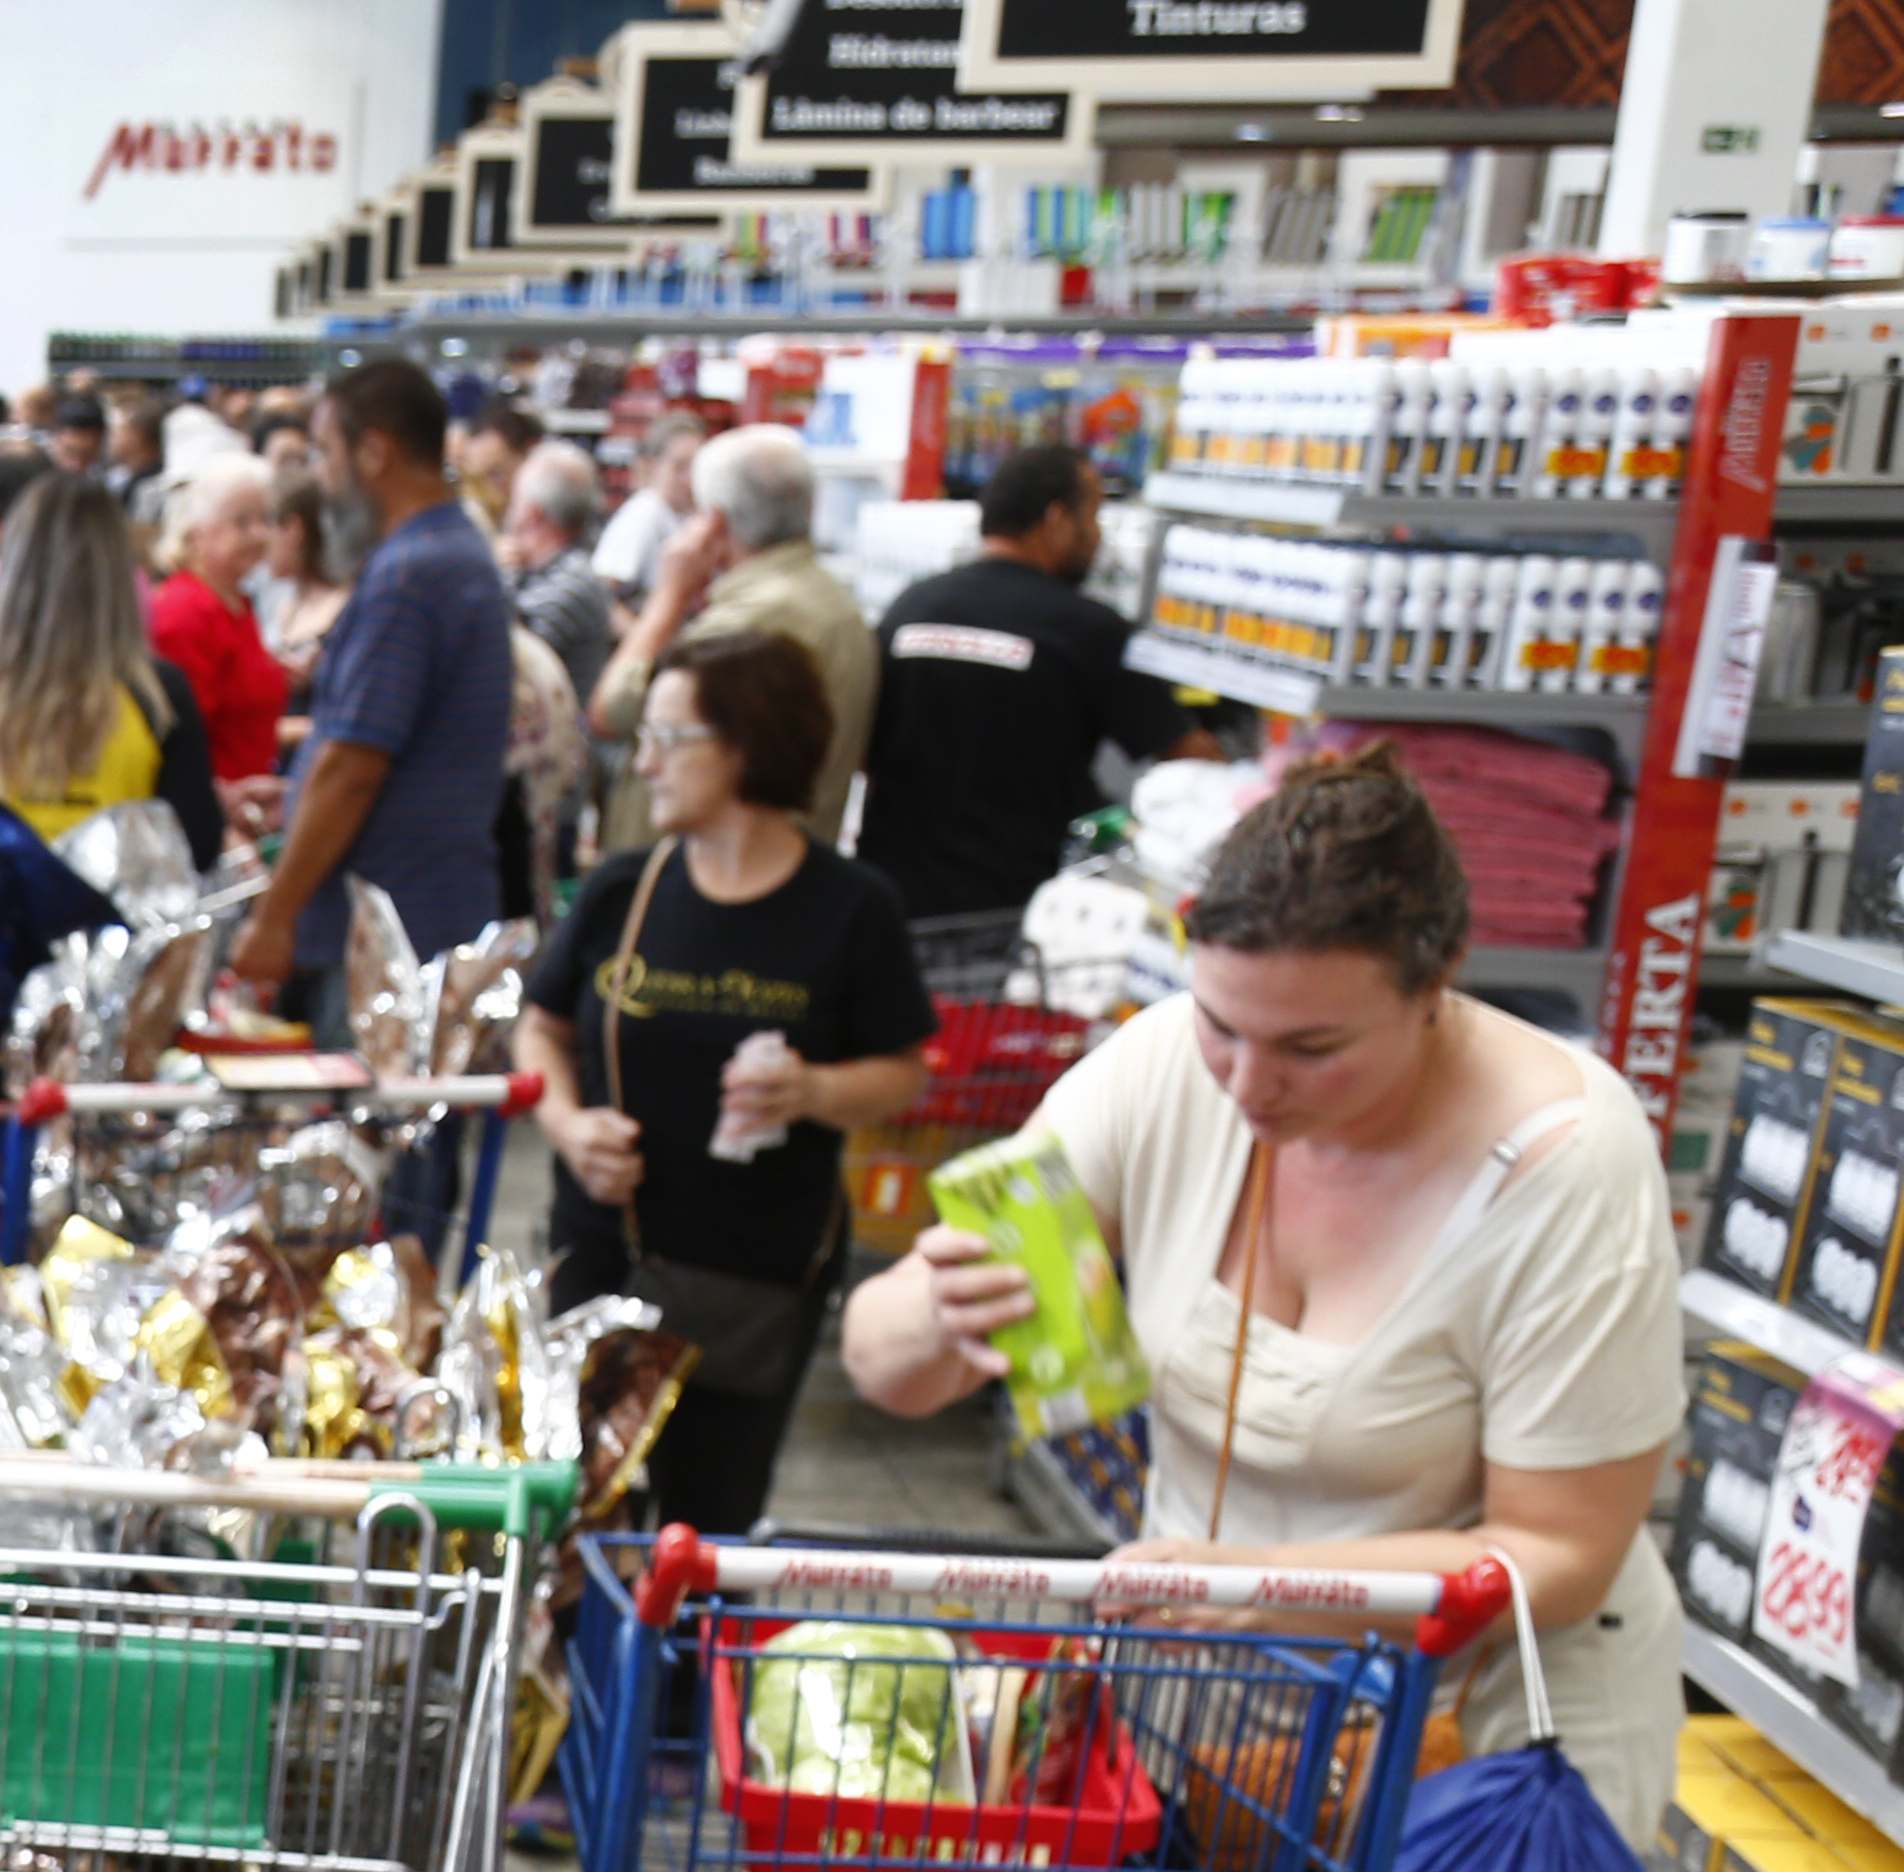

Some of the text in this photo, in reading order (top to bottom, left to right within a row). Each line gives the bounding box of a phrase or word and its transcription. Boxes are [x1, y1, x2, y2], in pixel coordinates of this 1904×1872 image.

[890, 95, 931, 129] de
[933, 95, 1059, 129] barbear
[1623, 893, 1700, 1135] FERTA
